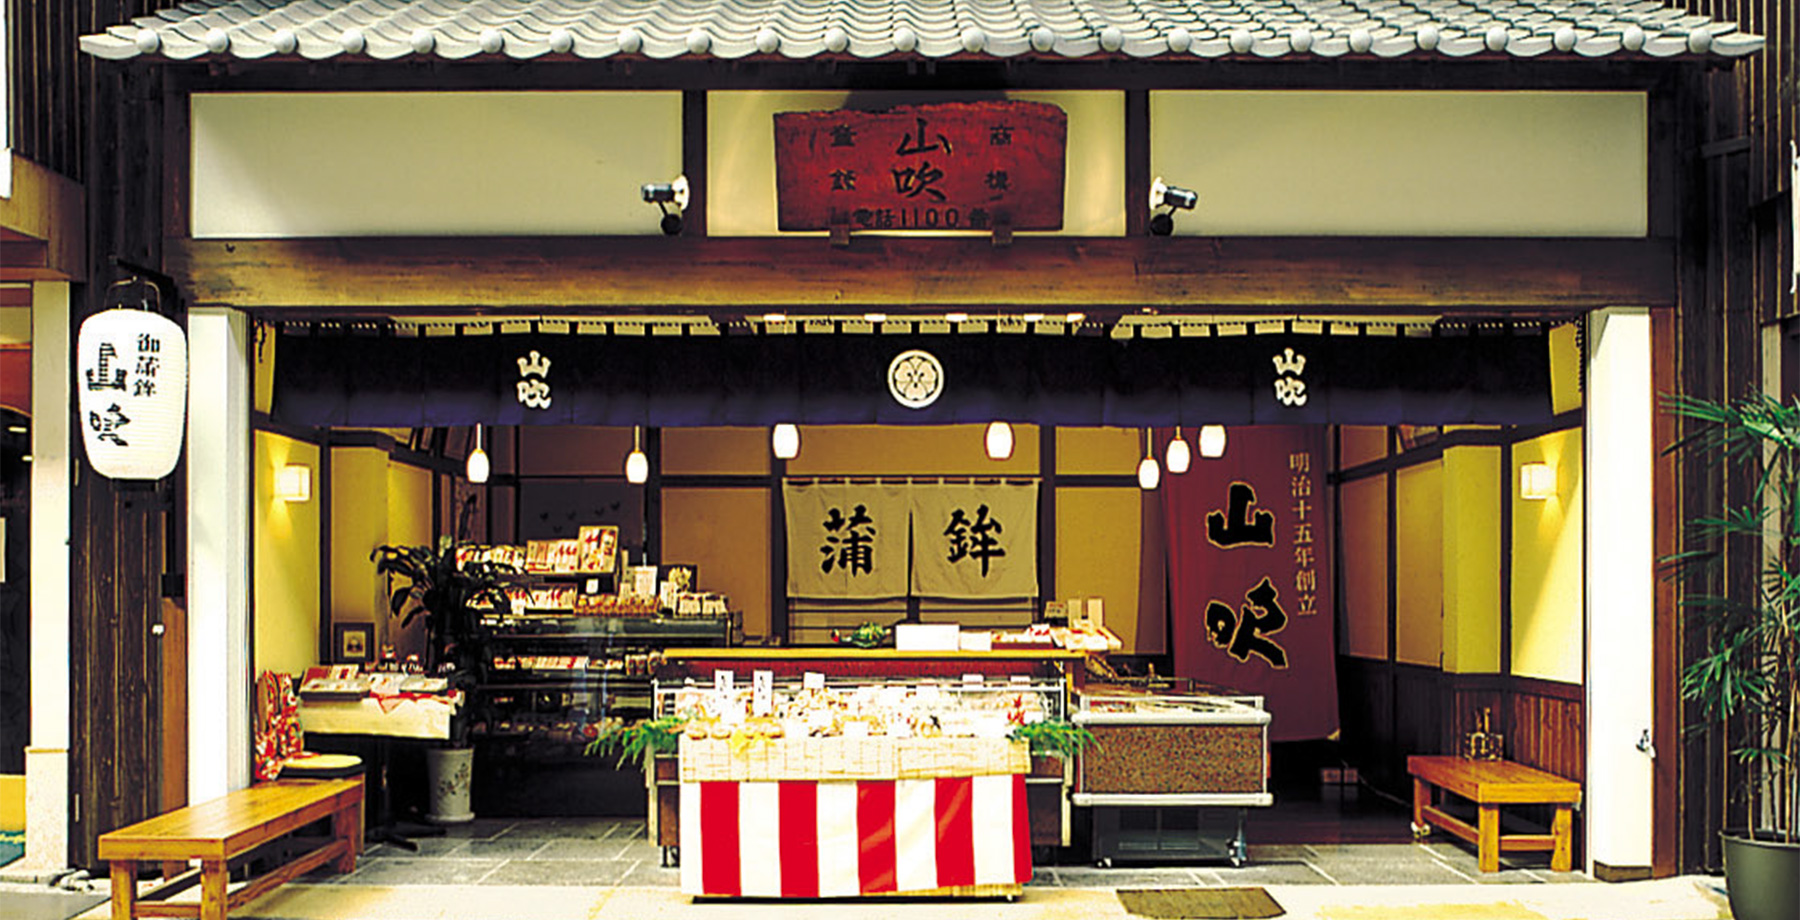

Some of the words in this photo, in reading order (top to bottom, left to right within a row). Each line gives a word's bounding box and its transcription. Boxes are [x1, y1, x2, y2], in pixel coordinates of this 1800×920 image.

[891, 117, 952, 201] 山吹
[86, 342, 131, 447] 山吹
[517, 350, 552, 410] 山吹
[1272, 347, 1307, 407] 山吹
[1205, 481, 1289, 669] 山吹
[1289, 452, 1317, 616] 明治十五年創立
